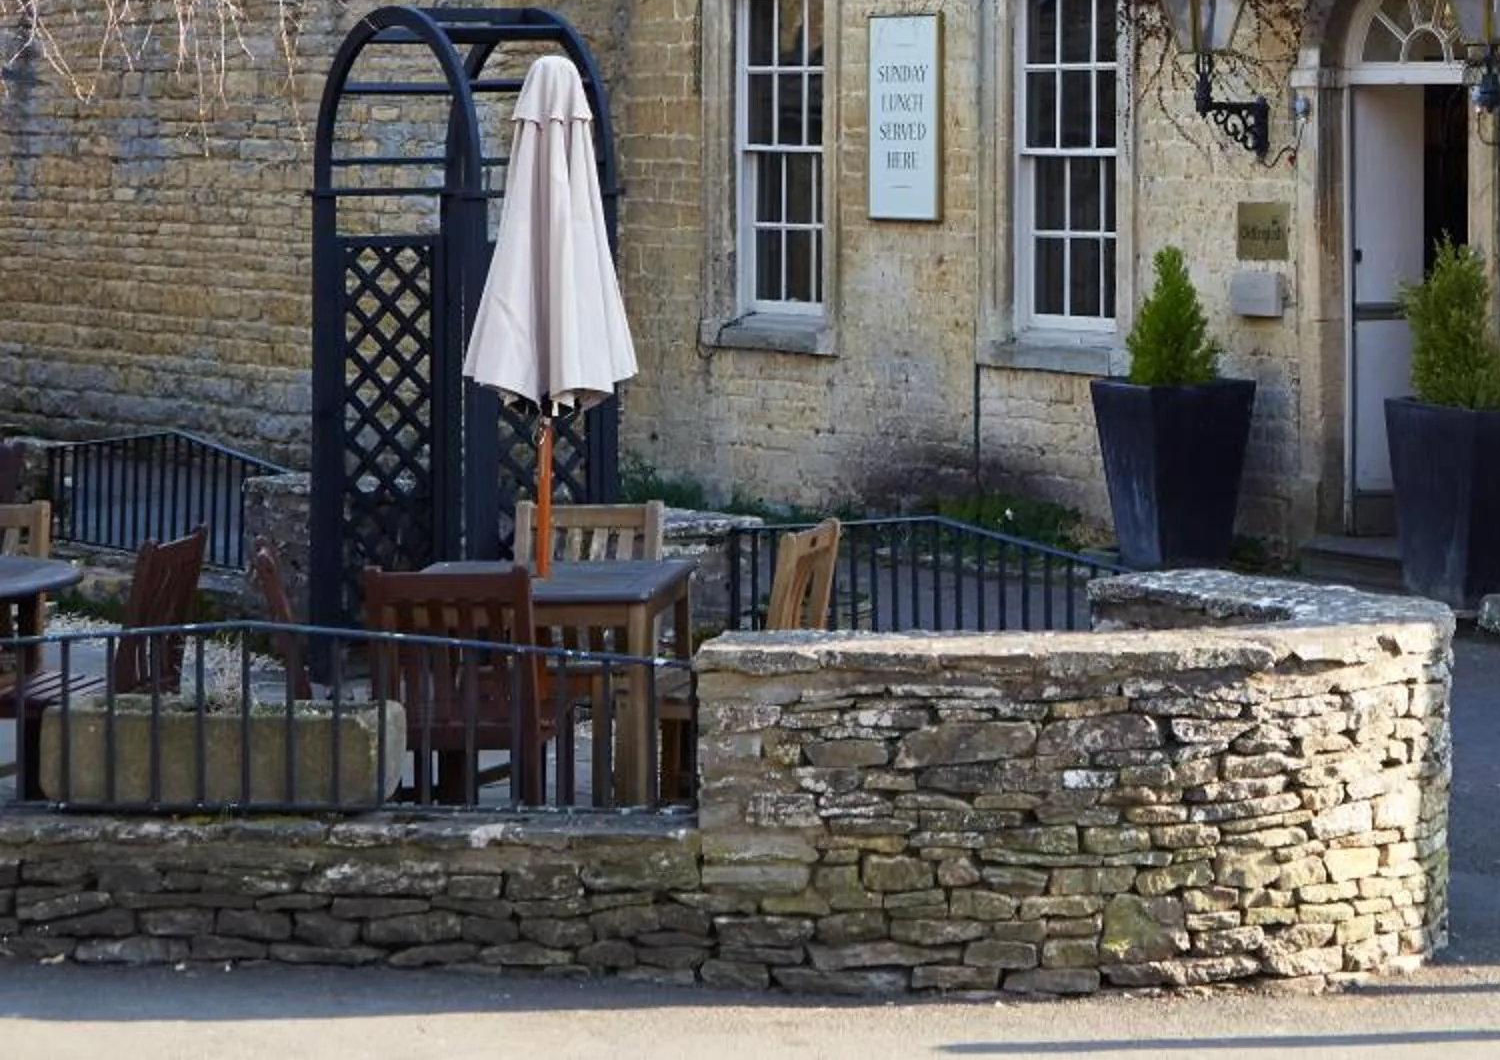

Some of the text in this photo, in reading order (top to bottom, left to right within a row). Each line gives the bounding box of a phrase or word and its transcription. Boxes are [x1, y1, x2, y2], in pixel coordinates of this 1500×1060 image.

[877, 64, 929, 83] SUNDAY
[881, 93, 924, 113] LUNCH
[879, 122, 927, 141] SERVED
[886, 151, 918, 170] HERE
